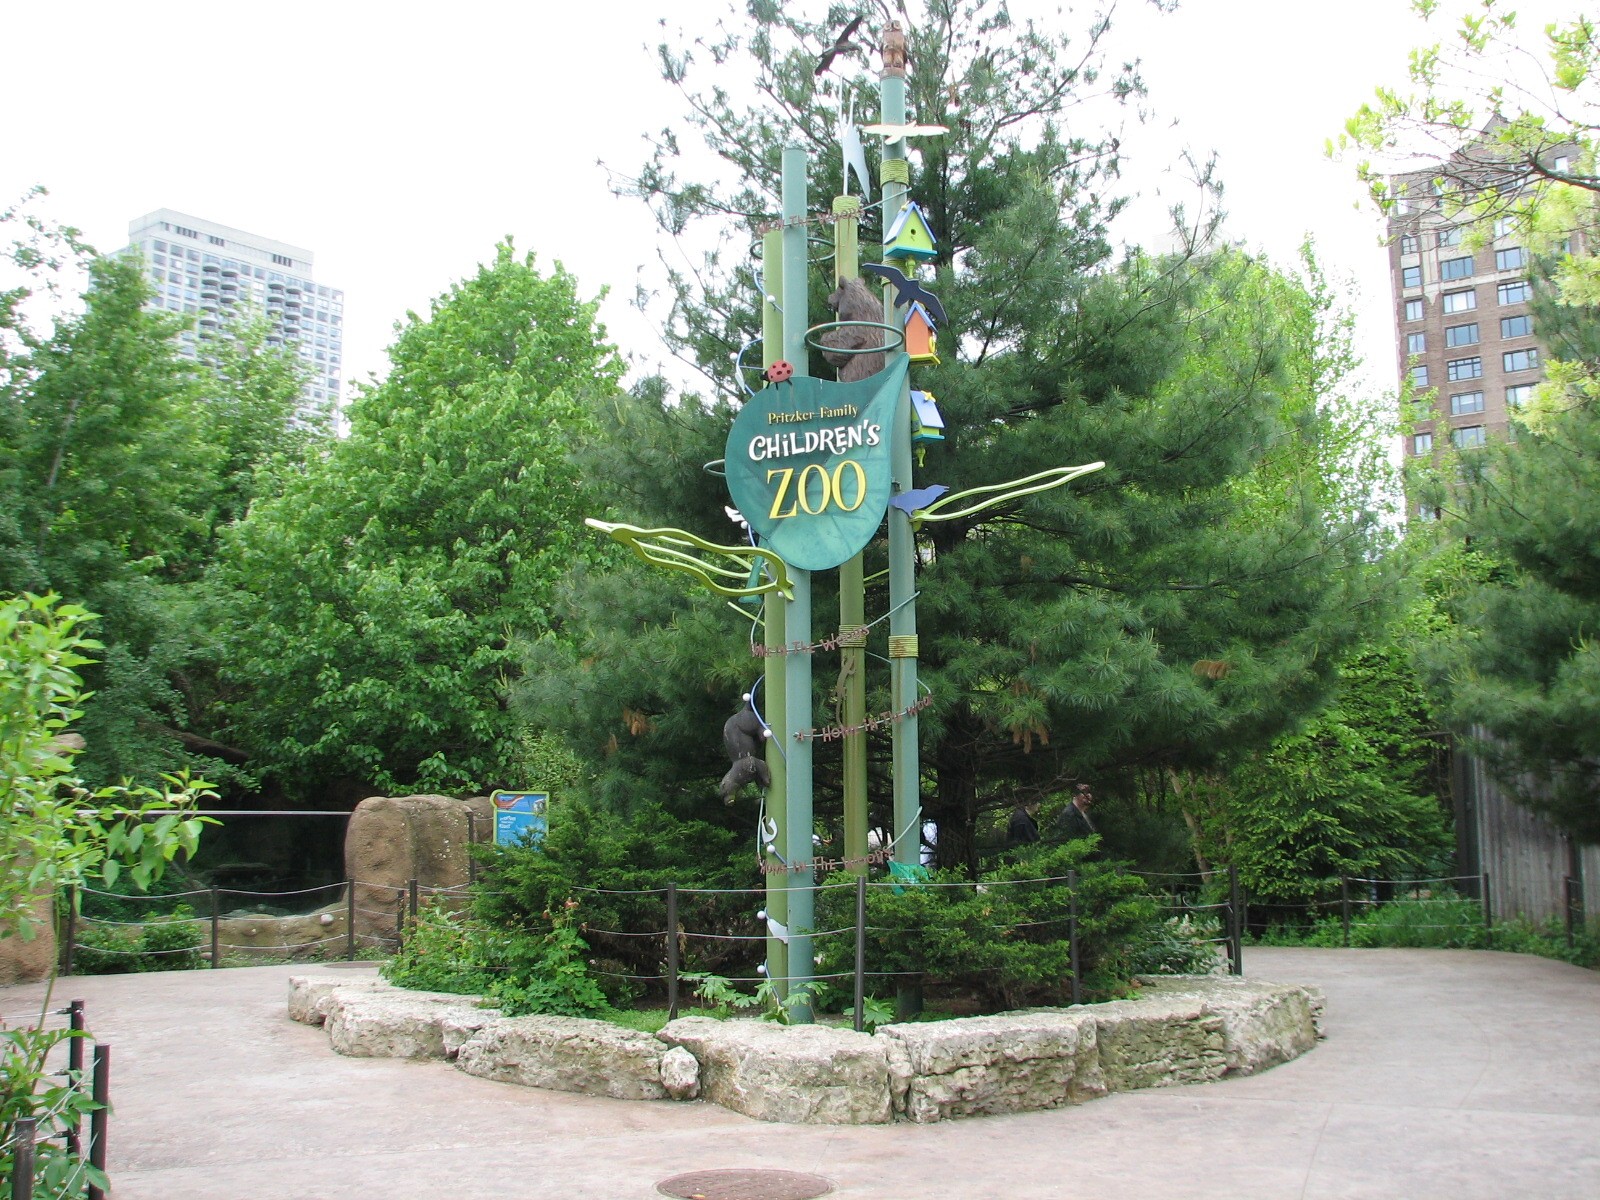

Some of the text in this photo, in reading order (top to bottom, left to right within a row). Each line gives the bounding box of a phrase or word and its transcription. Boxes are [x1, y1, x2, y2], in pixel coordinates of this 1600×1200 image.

[768, 404, 859, 425] Pritzker Family
[767, 459, 867, 520] ZOO
